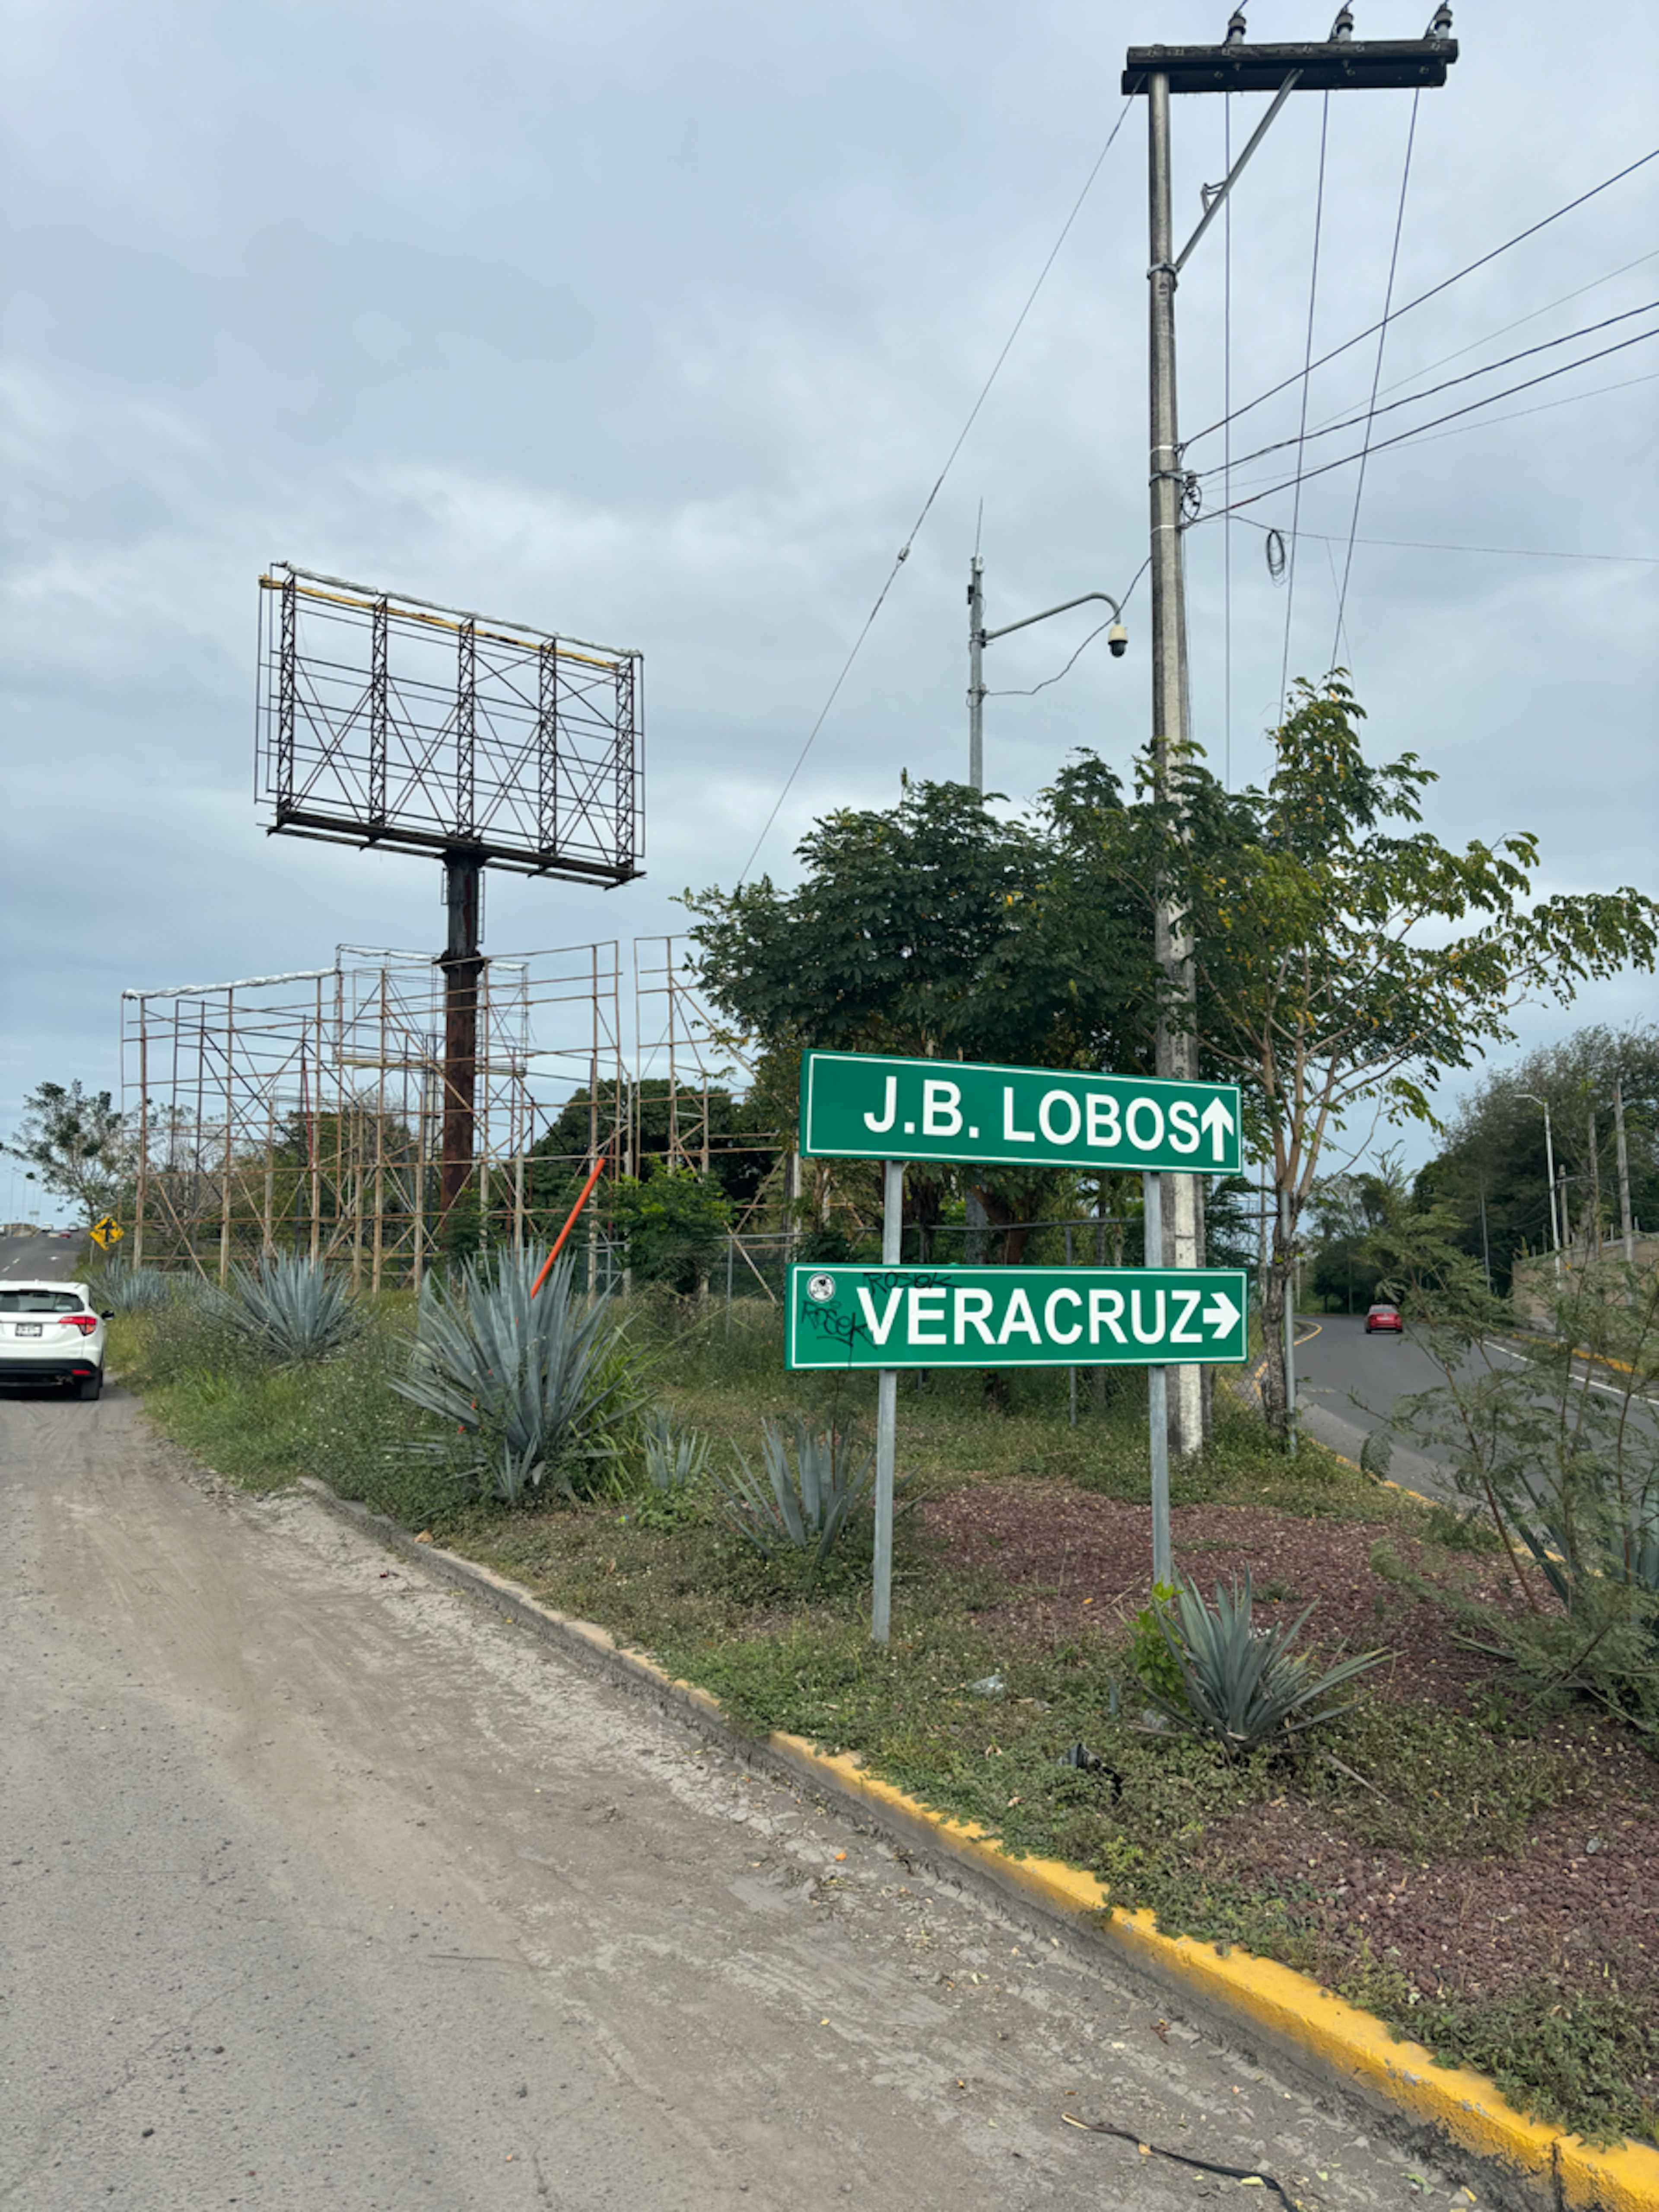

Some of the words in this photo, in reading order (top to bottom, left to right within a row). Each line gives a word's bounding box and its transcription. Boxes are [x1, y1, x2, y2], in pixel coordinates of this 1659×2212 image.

[863, 1076, 979, 1138] J.B.
[1003, 1087, 1200, 1154] LOBOS
[857, 1287, 1203, 1345] VERACRUZ
